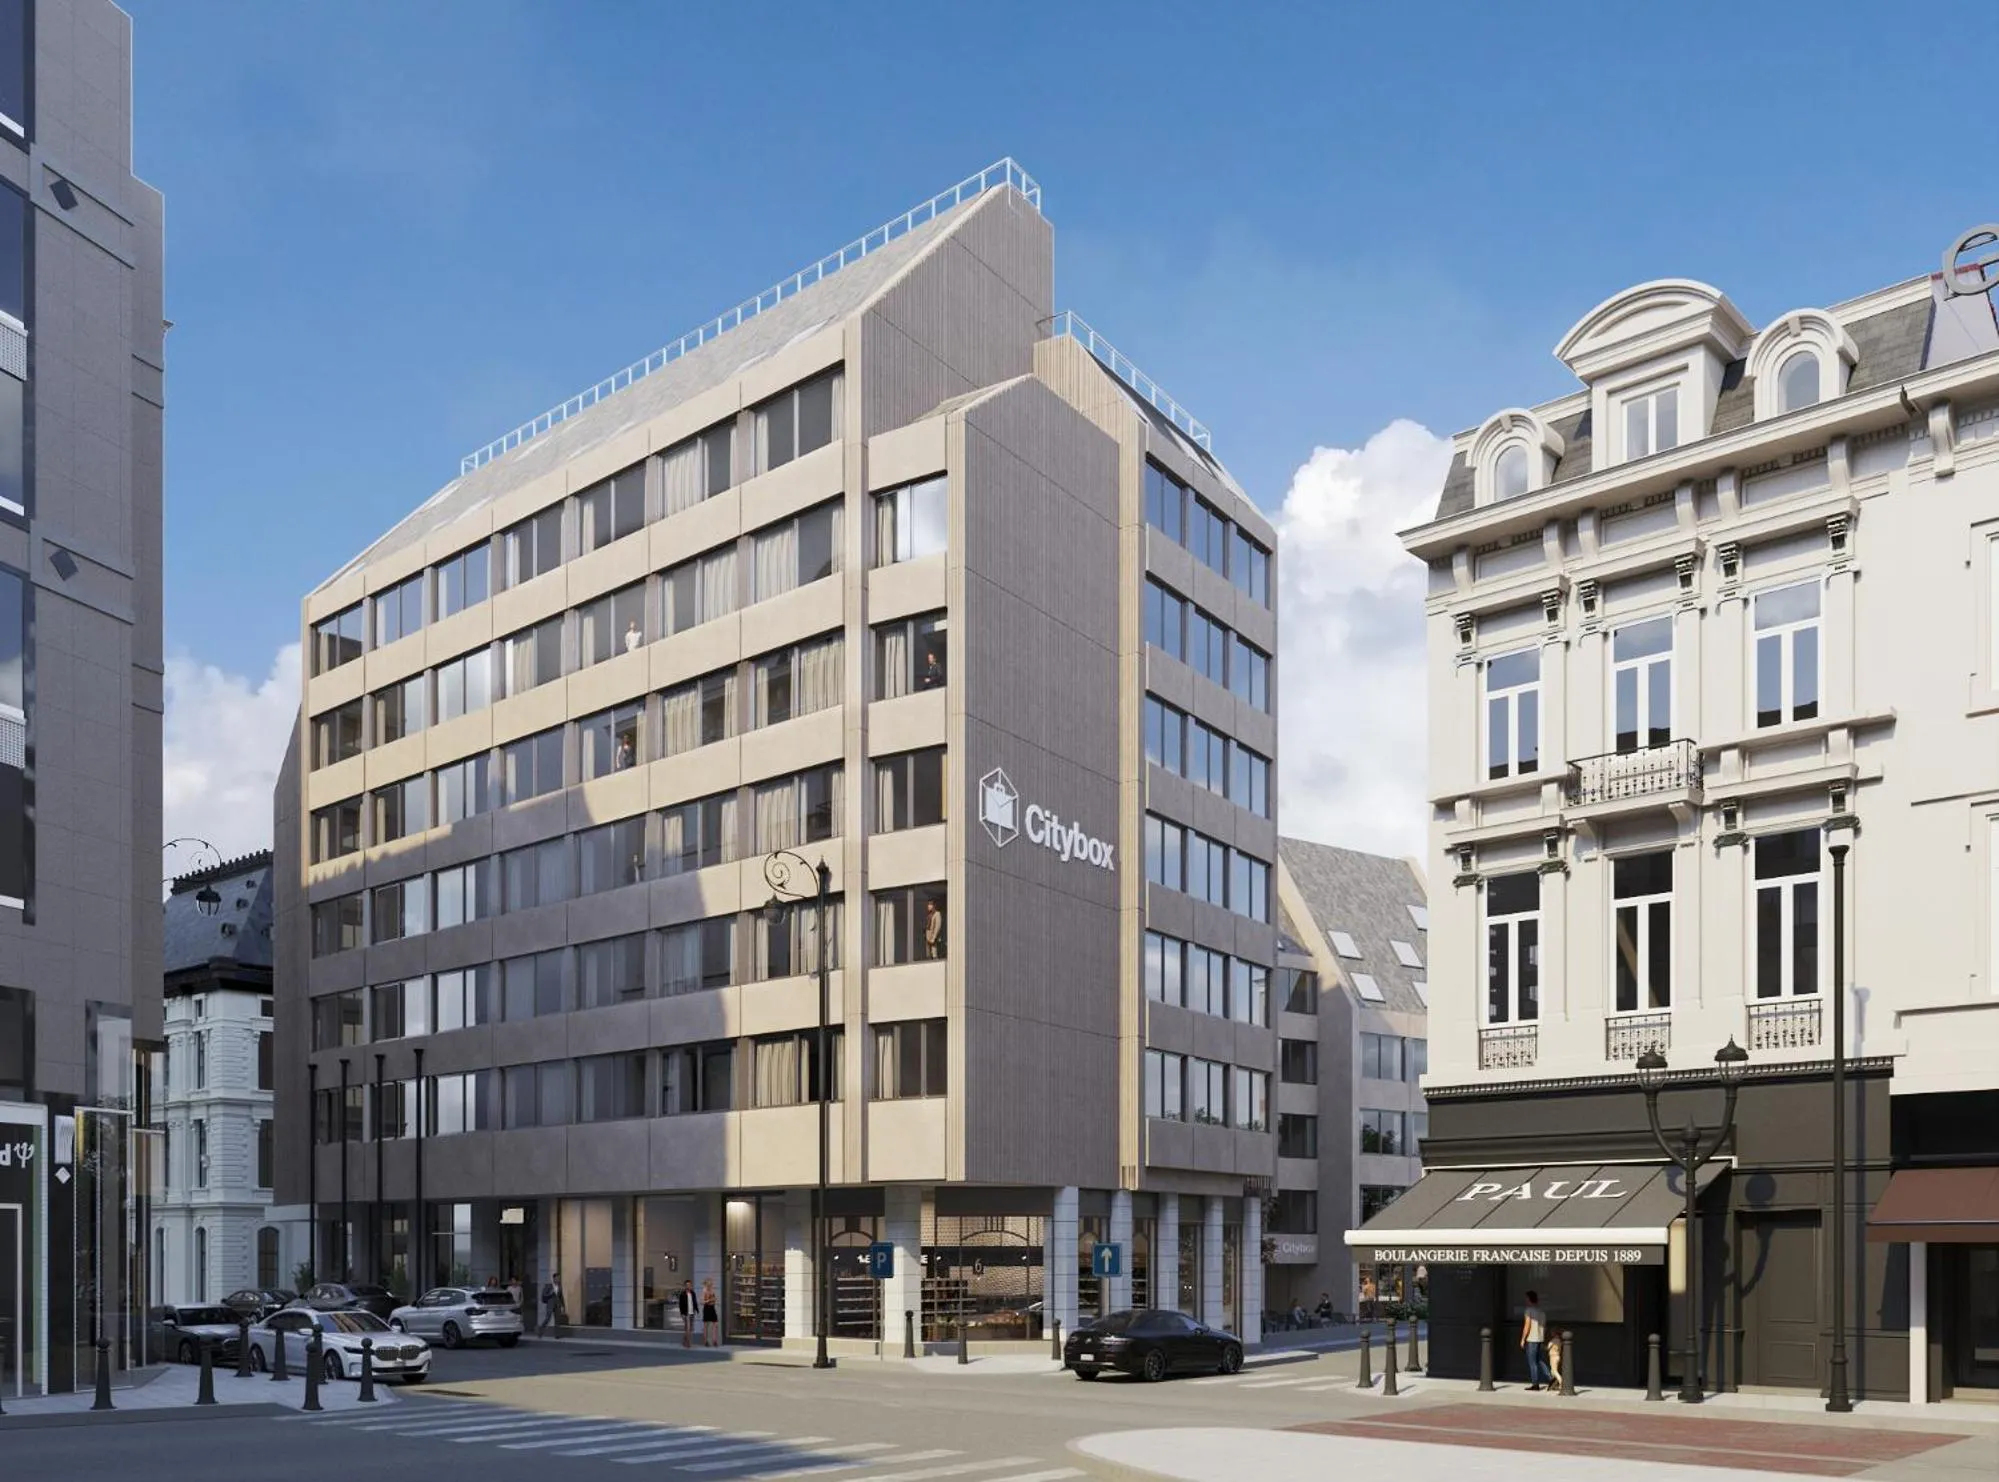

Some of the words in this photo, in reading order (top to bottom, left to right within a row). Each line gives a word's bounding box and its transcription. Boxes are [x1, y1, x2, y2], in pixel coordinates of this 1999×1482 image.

[1025, 804, 1114, 871] Citybox
[1455, 1179, 1627, 1201] PAUL
[878, 1252, 887, 1268] P
[1374, 1249, 1469, 1262] BOULANGERIE
[1473, 1249, 1551, 1262] FRANCAISE
[1555, 1249, 1608, 1262] DEPUIS
[1613, 1249, 1642, 1263] 1889
